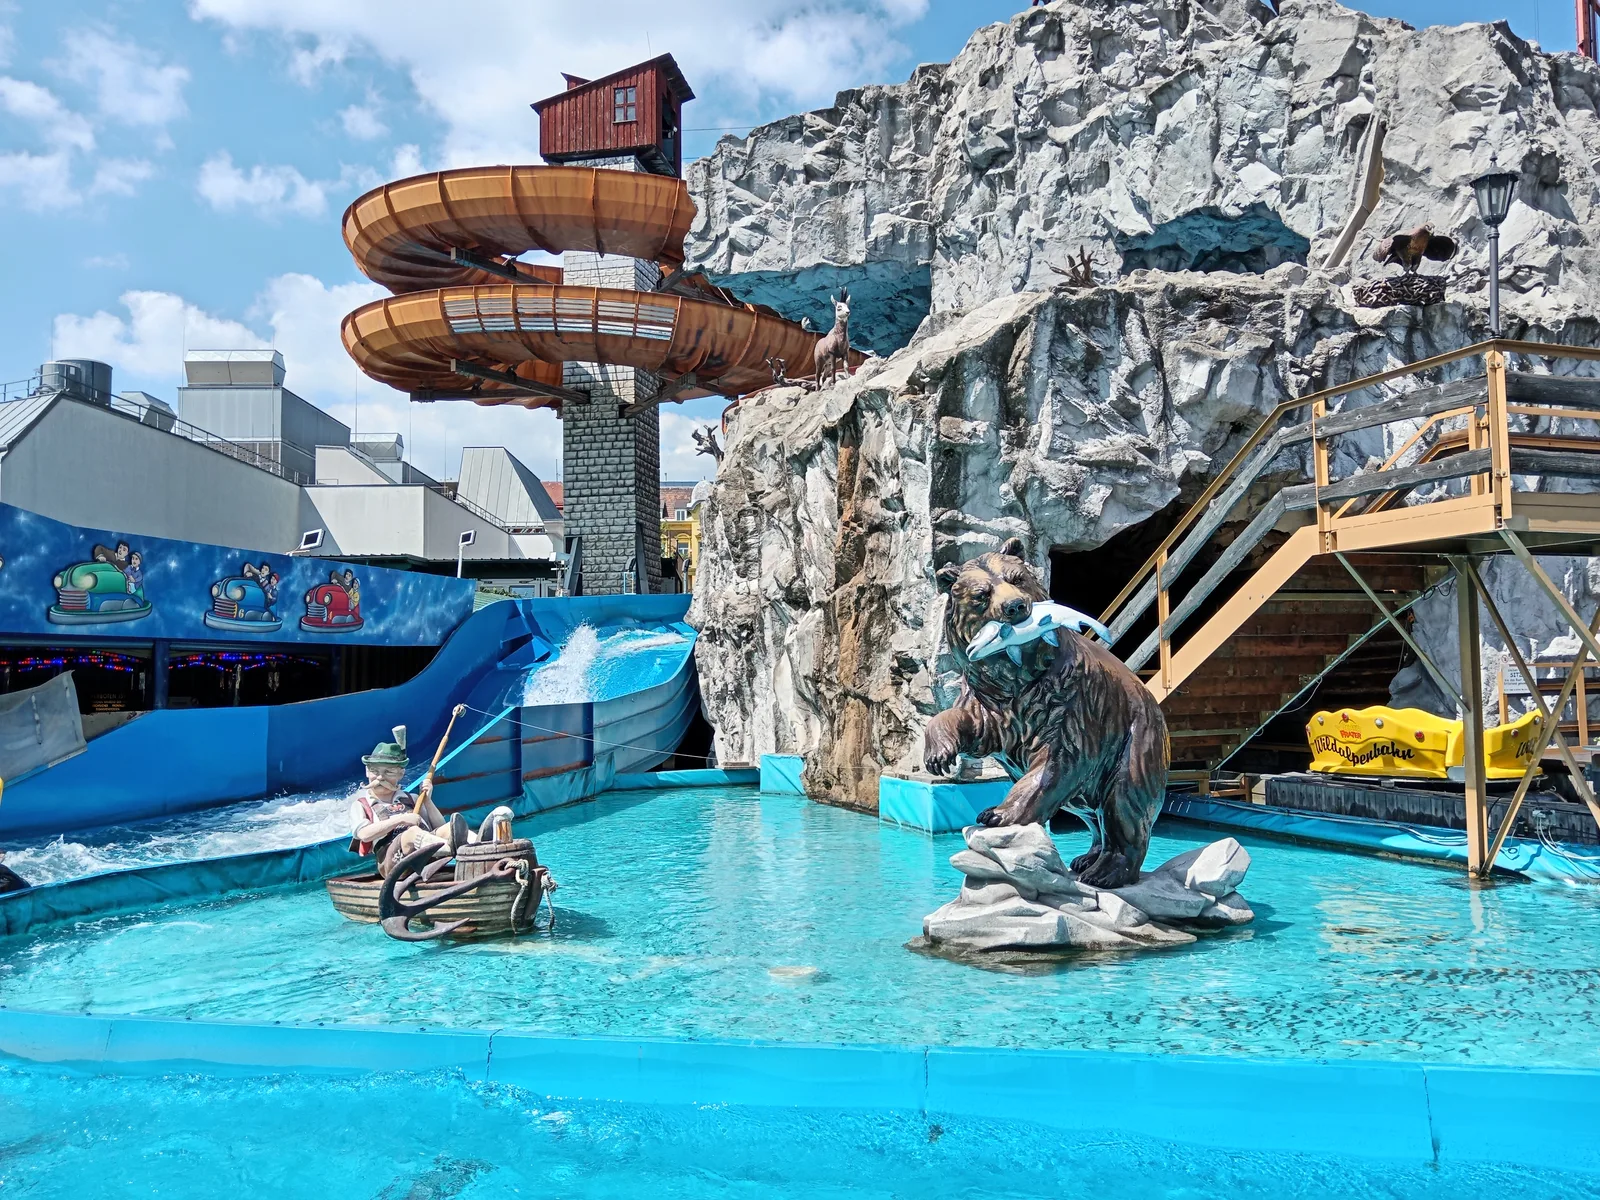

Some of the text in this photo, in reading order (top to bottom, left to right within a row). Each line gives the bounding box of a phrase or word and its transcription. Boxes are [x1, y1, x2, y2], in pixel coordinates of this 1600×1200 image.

[238, 609, 245, 618] 6
[1340, 729, 1362, 740] PRATER
[1314, 736, 1415, 767] Wildalpenbahn
